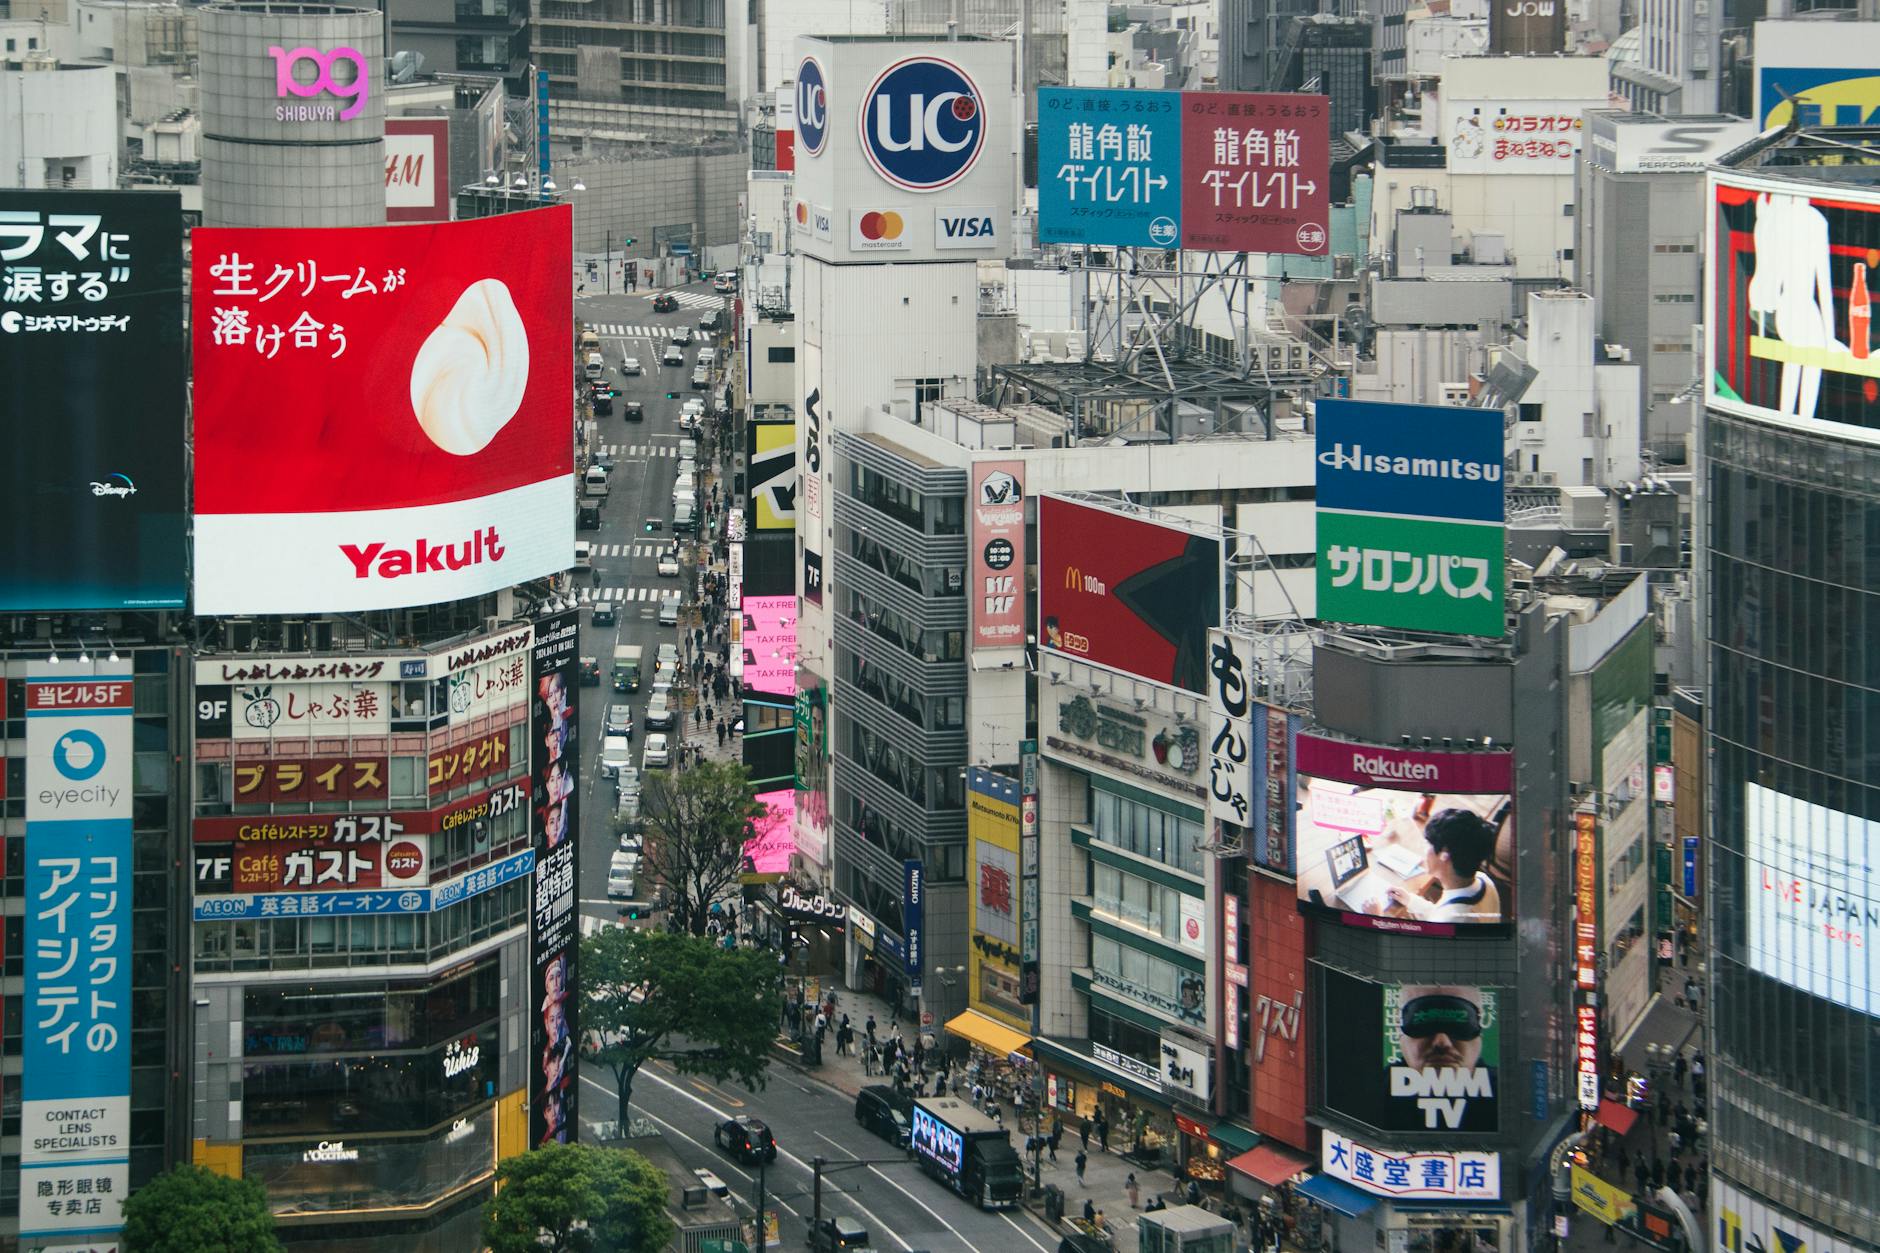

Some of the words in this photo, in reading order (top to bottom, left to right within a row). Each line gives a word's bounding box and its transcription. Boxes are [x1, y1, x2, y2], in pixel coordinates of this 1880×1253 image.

[268, 45, 369, 122] 109
[275, 105, 335, 122] SHIBUYA
[1505, 116, 1573, 132] カラオケ
[1069, 123, 1152, 162] 龍角散
[1213, 127, 1299, 168] 龍角散
[1494, 139, 1573, 160] まねきねこ
[815, 214, 829, 233] VISA
[940, 217, 994, 237] VISA
[209, 252, 406, 302] 生クリームが
[24, 315, 131, 333] シネマトゥデイ
[211, 306, 347, 360] 溶け合う
[1318, 443, 1501, 482] Hisamitsu
[338, 525, 505, 579] Yakult
[807, 564, 820, 588] 7F
[1084, 575, 1105, 596] 100m
[1327, 545, 1493, 601] サロンパス
[756, 600, 775, 609] TAX
[756, 635, 775, 643] TAX
[222, 661, 384, 681] しゃぶしゃぶバイキング
[476, 657, 523, 699] しゃぶ葉
[757, 669, 775, 677] TAX
[37, 685, 123, 706] 当ビル5F
[198, 701, 227, 720] 9F
[288, 689, 378, 719] しゃぶ葉
[1211, 636, 1248, 821] もんじゃ
[429, 736, 506, 785] コンタクト
[1353, 753, 1438, 780] Rakuten
[236, 762, 382, 794] プライス
[39, 786, 120, 808] eyecity
[489, 784, 525, 818] ガスト
[973, 801, 1005, 819] Matsumoto
[333, 816, 404, 843] ガスト
[196, 858, 231, 880] 7F
[239, 854, 279, 872] Café
[283, 850, 373, 886] ガスト
[390, 859, 419, 869] ガスト
[466, 855, 532, 894] 英会話イーオン
[536, 841, 573, 883] 僕たちは
[536, 861, 573, 912] 超特急
[911, 869, 919, 904] MIZUHO
[201, 899, 247, 915] AEON
[260, 894, 392, 916] 英会話イーオン
[399, 893, 421, 909] 6F
[783, 886, 845, 919] グルメタウン
[1810, 888, 1879, 928] JAPAN
[37, 858, 81, 1055] アイシティ
[86, 856, 118, 1053] コンタクトの
[1256, 990, 1304, 1064] クスリ
[443, 1046, 479, 1078] Ushi8
[1391, 1066, 1493, 1098] DMM
[46, 1108, 107, 1122] CONTACT
[1417, 1098, 1466, 1129] TV
[34, 1135, 117, 1149] SPECIALISTS
[60, 1123, 92, 1135] LENS
[1331, 1141, 1486, 1188] 大盛堂書店
[37, 1177, 112, 1197] 隐形眼镜
[46, 1199, 102, 1216] 专卖店
